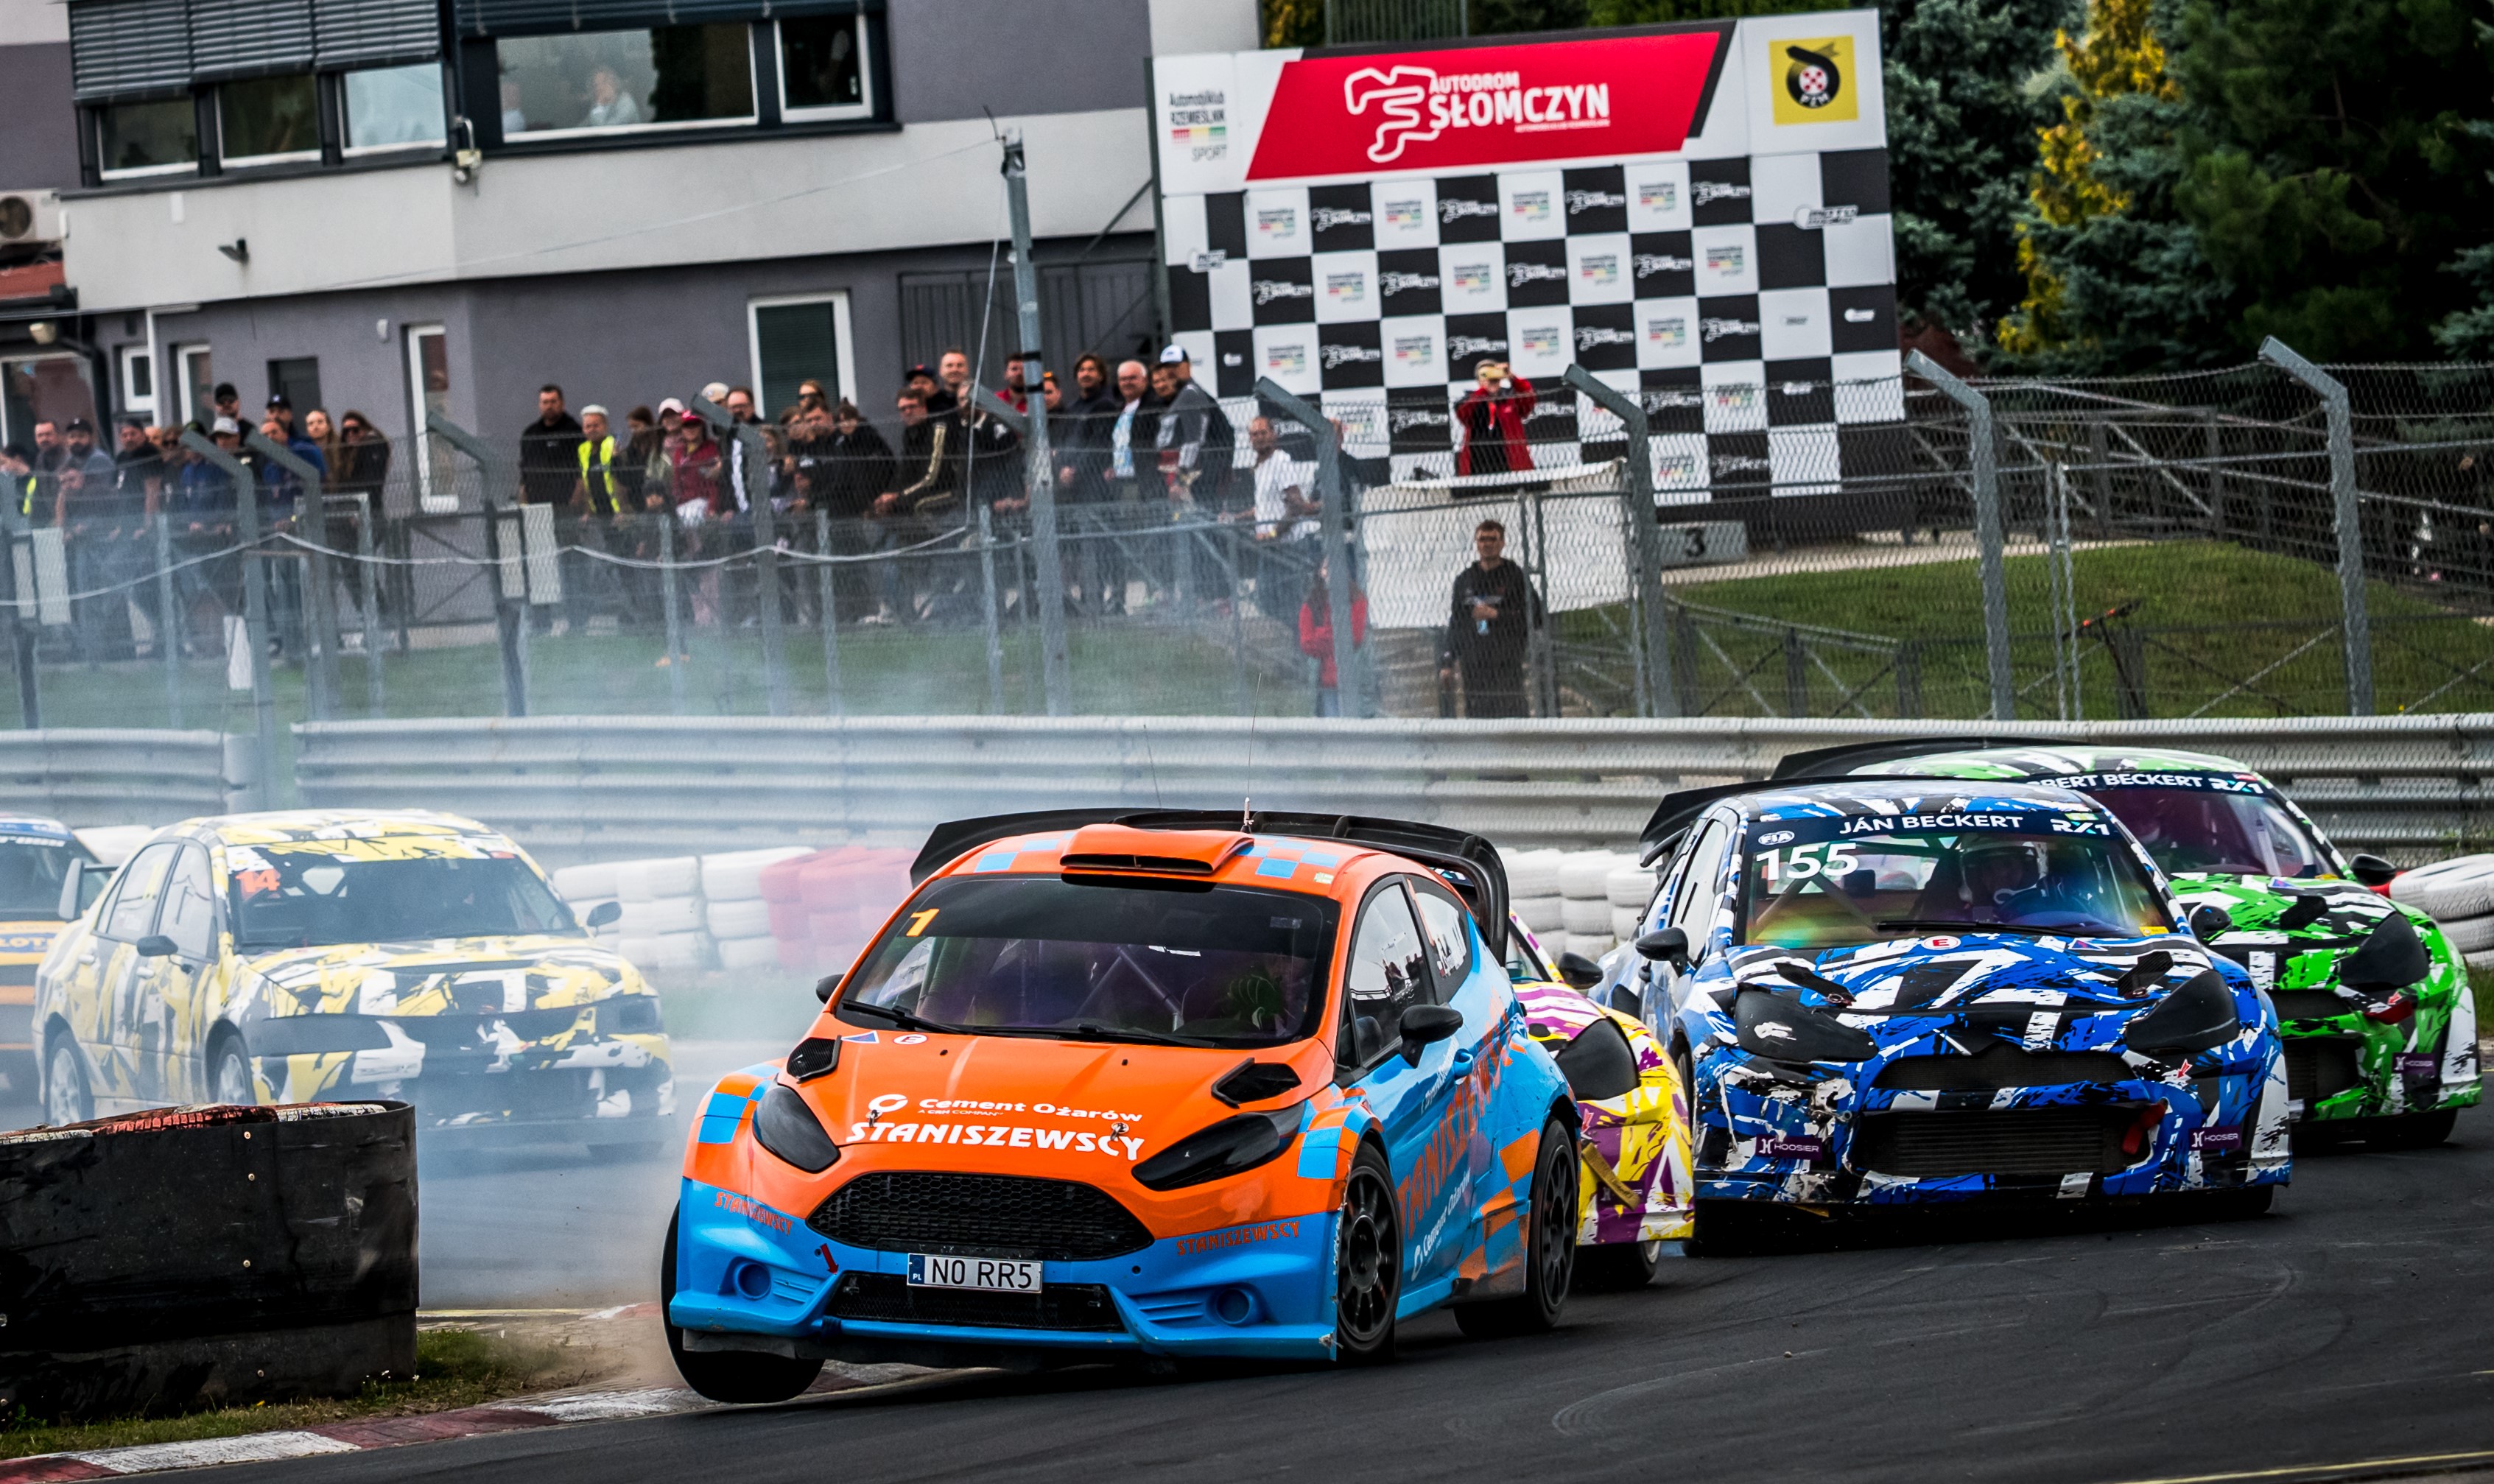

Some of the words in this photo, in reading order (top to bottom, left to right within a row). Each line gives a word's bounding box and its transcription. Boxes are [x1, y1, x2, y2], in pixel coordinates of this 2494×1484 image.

[1428, 82, 1610, 130] SŁOMCZYN
[1685, 528, 1706, 558] 3
[2104, 773, 2202, 787] BECKERT
[2207, 778, 2263, 794] RX1
[1838, 817, 1894, 835] JÁN
[1903, 814, 2023, 830] BECKERT
[2050, 818, 2110, 836] RX1
[1756, 843, 1859, 881] 155
[236, 868, 281, 892] 14
[906, 908, 940, 937] 1
[919, 1099, 1026, 1111] Cement
[1033, 1103, 1143, 1122] Ożarów
[846, 1122, 1145, 1161] STANISZEWSCY
[1774, 1143, 1819, 1153] HOOSIER
[1176, 1220, 1299, 1256] STANISZEWSCY
[913, 1273, 922, 1281] PL
[977, 1262, 1032, 1289] RR5
